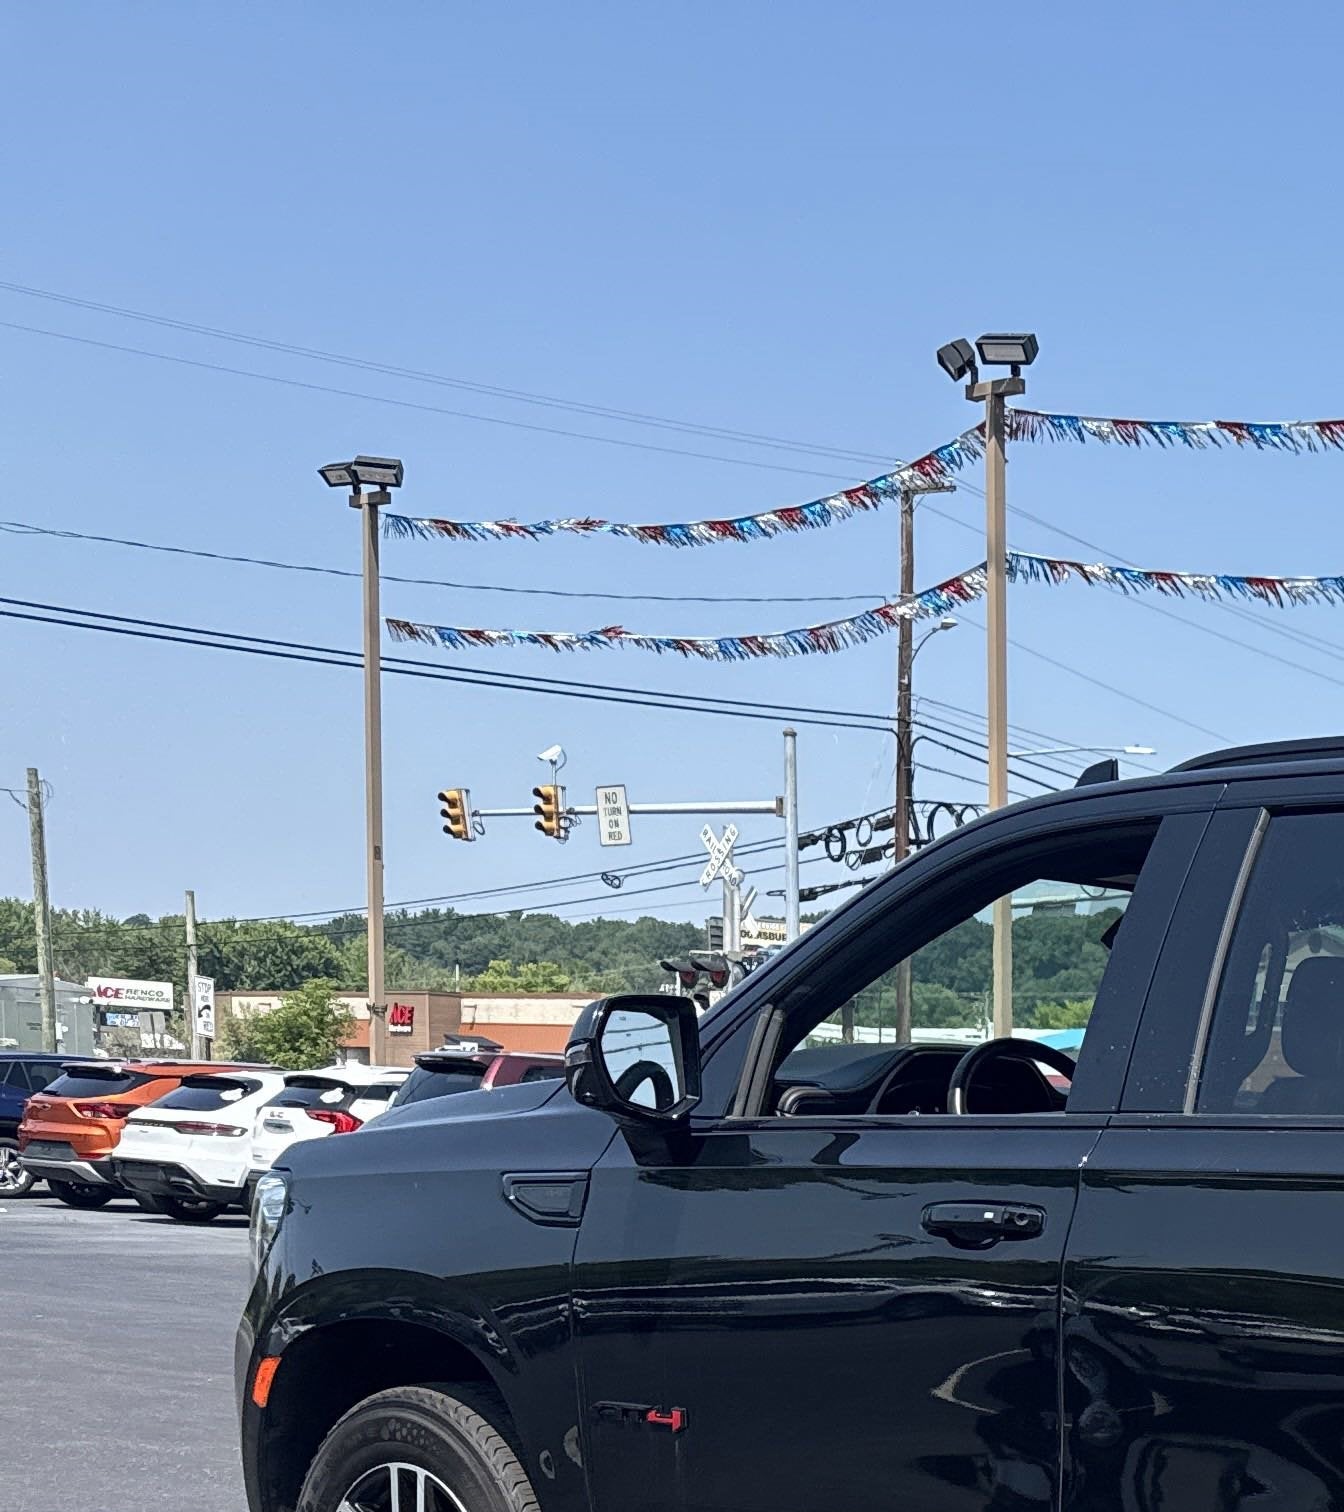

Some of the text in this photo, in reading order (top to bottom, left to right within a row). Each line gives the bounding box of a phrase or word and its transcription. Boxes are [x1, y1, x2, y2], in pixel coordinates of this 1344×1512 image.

[604, 791, 618, 805] NO
[603, 806, 622, 817] TURN
[608, 818, 620, 829] ON
[608, 830, 623, 841] RED
[90, 984, 125, 1000] ACE
[389, 1002, 415, 1026] ACE
